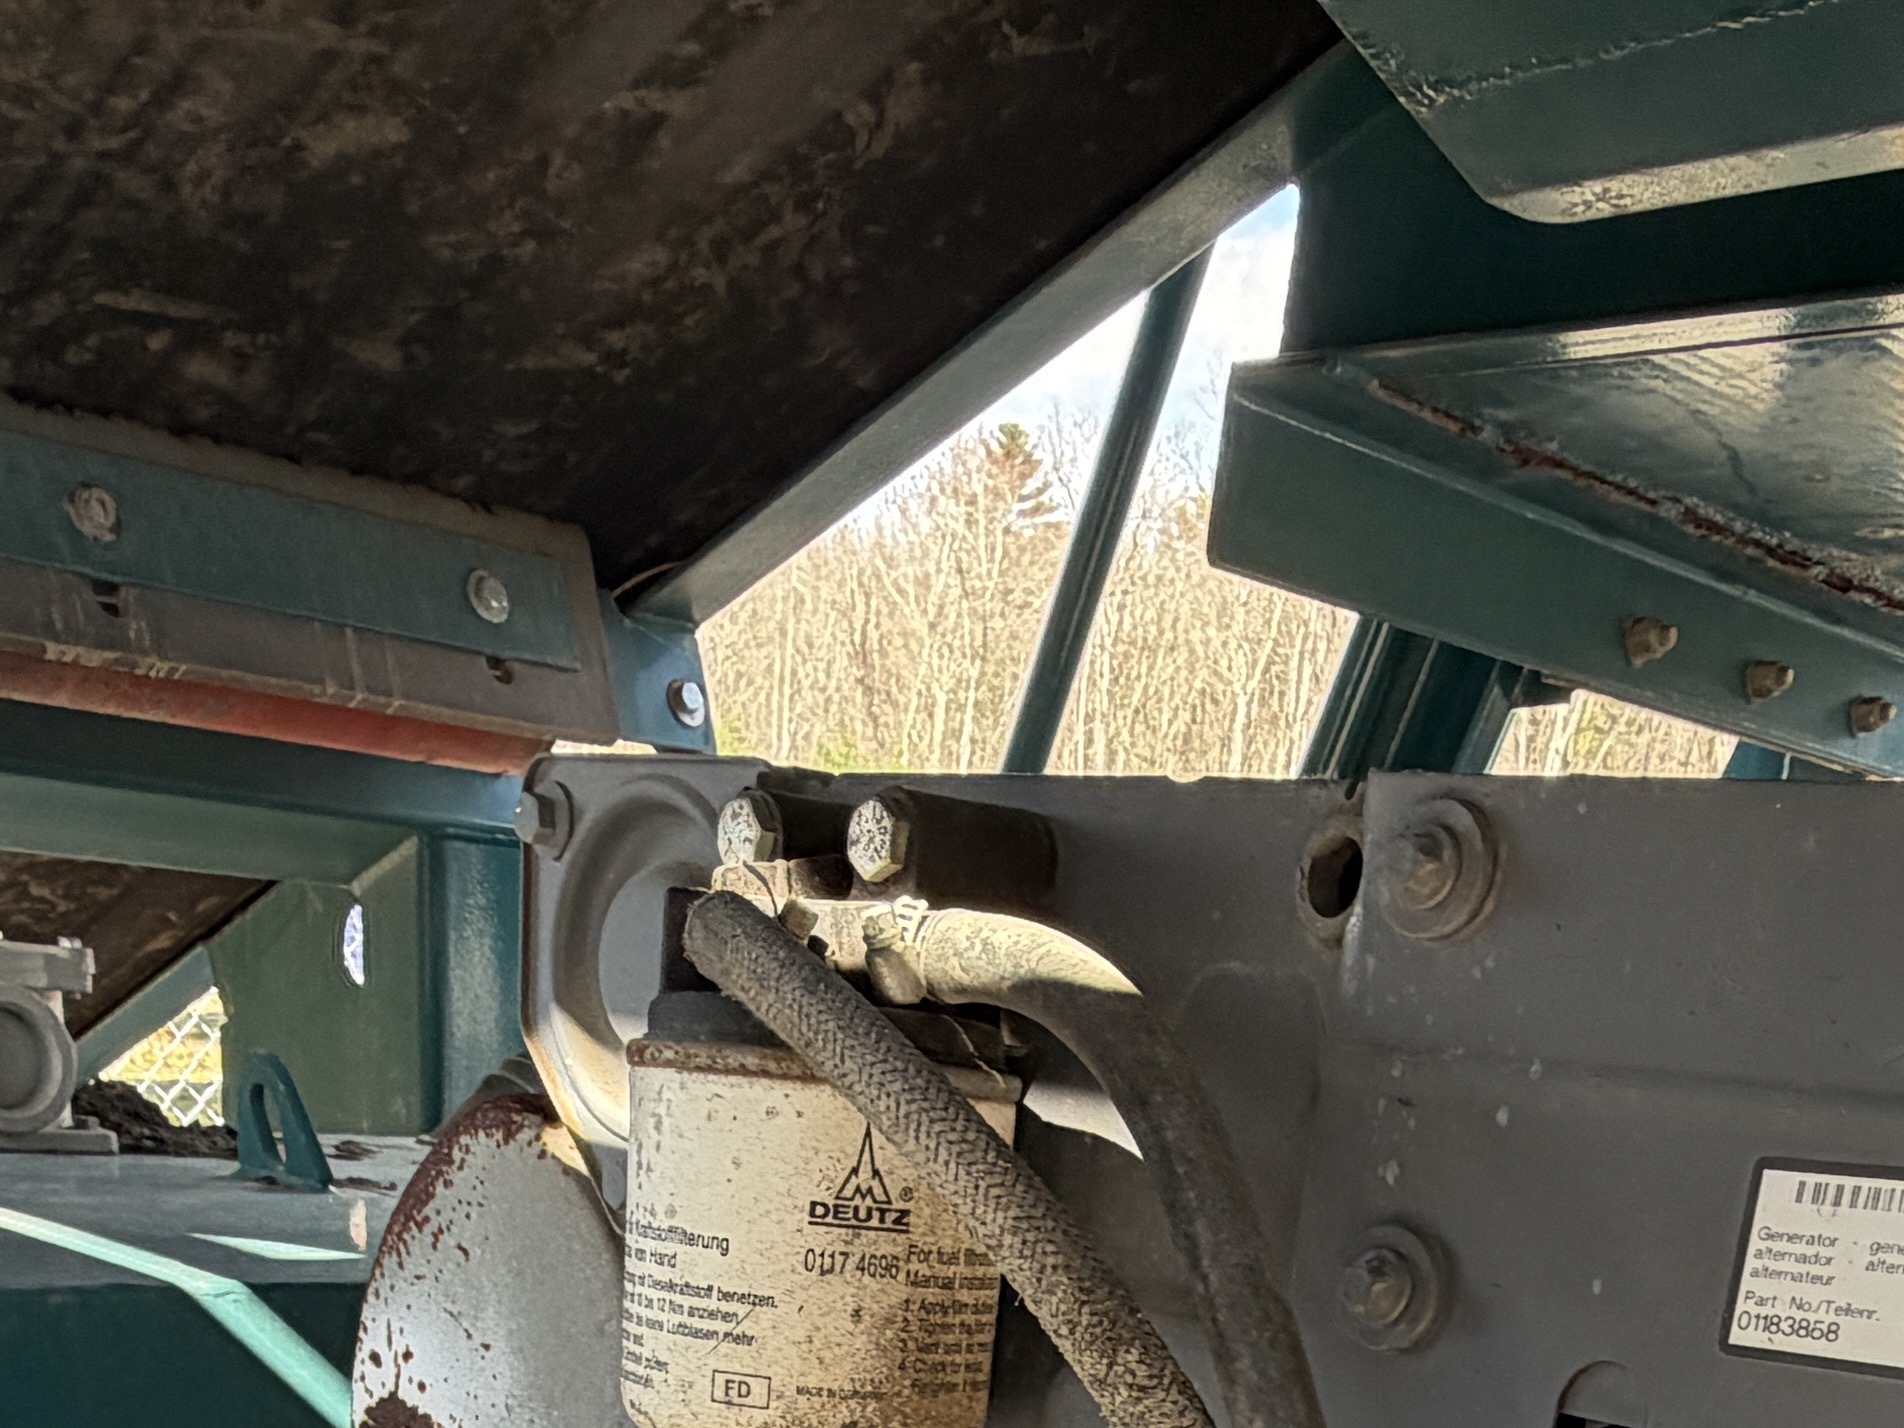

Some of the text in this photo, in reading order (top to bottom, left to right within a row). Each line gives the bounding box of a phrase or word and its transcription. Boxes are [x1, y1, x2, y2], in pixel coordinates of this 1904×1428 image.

[809, 1201, 911, 1227] DEUTZ
[1757, 1226, 1840, 1248] Generator
[854, 1253, 900, 1280] 4696
[1752, 1246, 1834, 1267] alternador
[1749, 1265, 1836, 1286] alternateur
[1743, 1290, 1777, 1309] Part
[724, 1378, 751, 1399] FD
